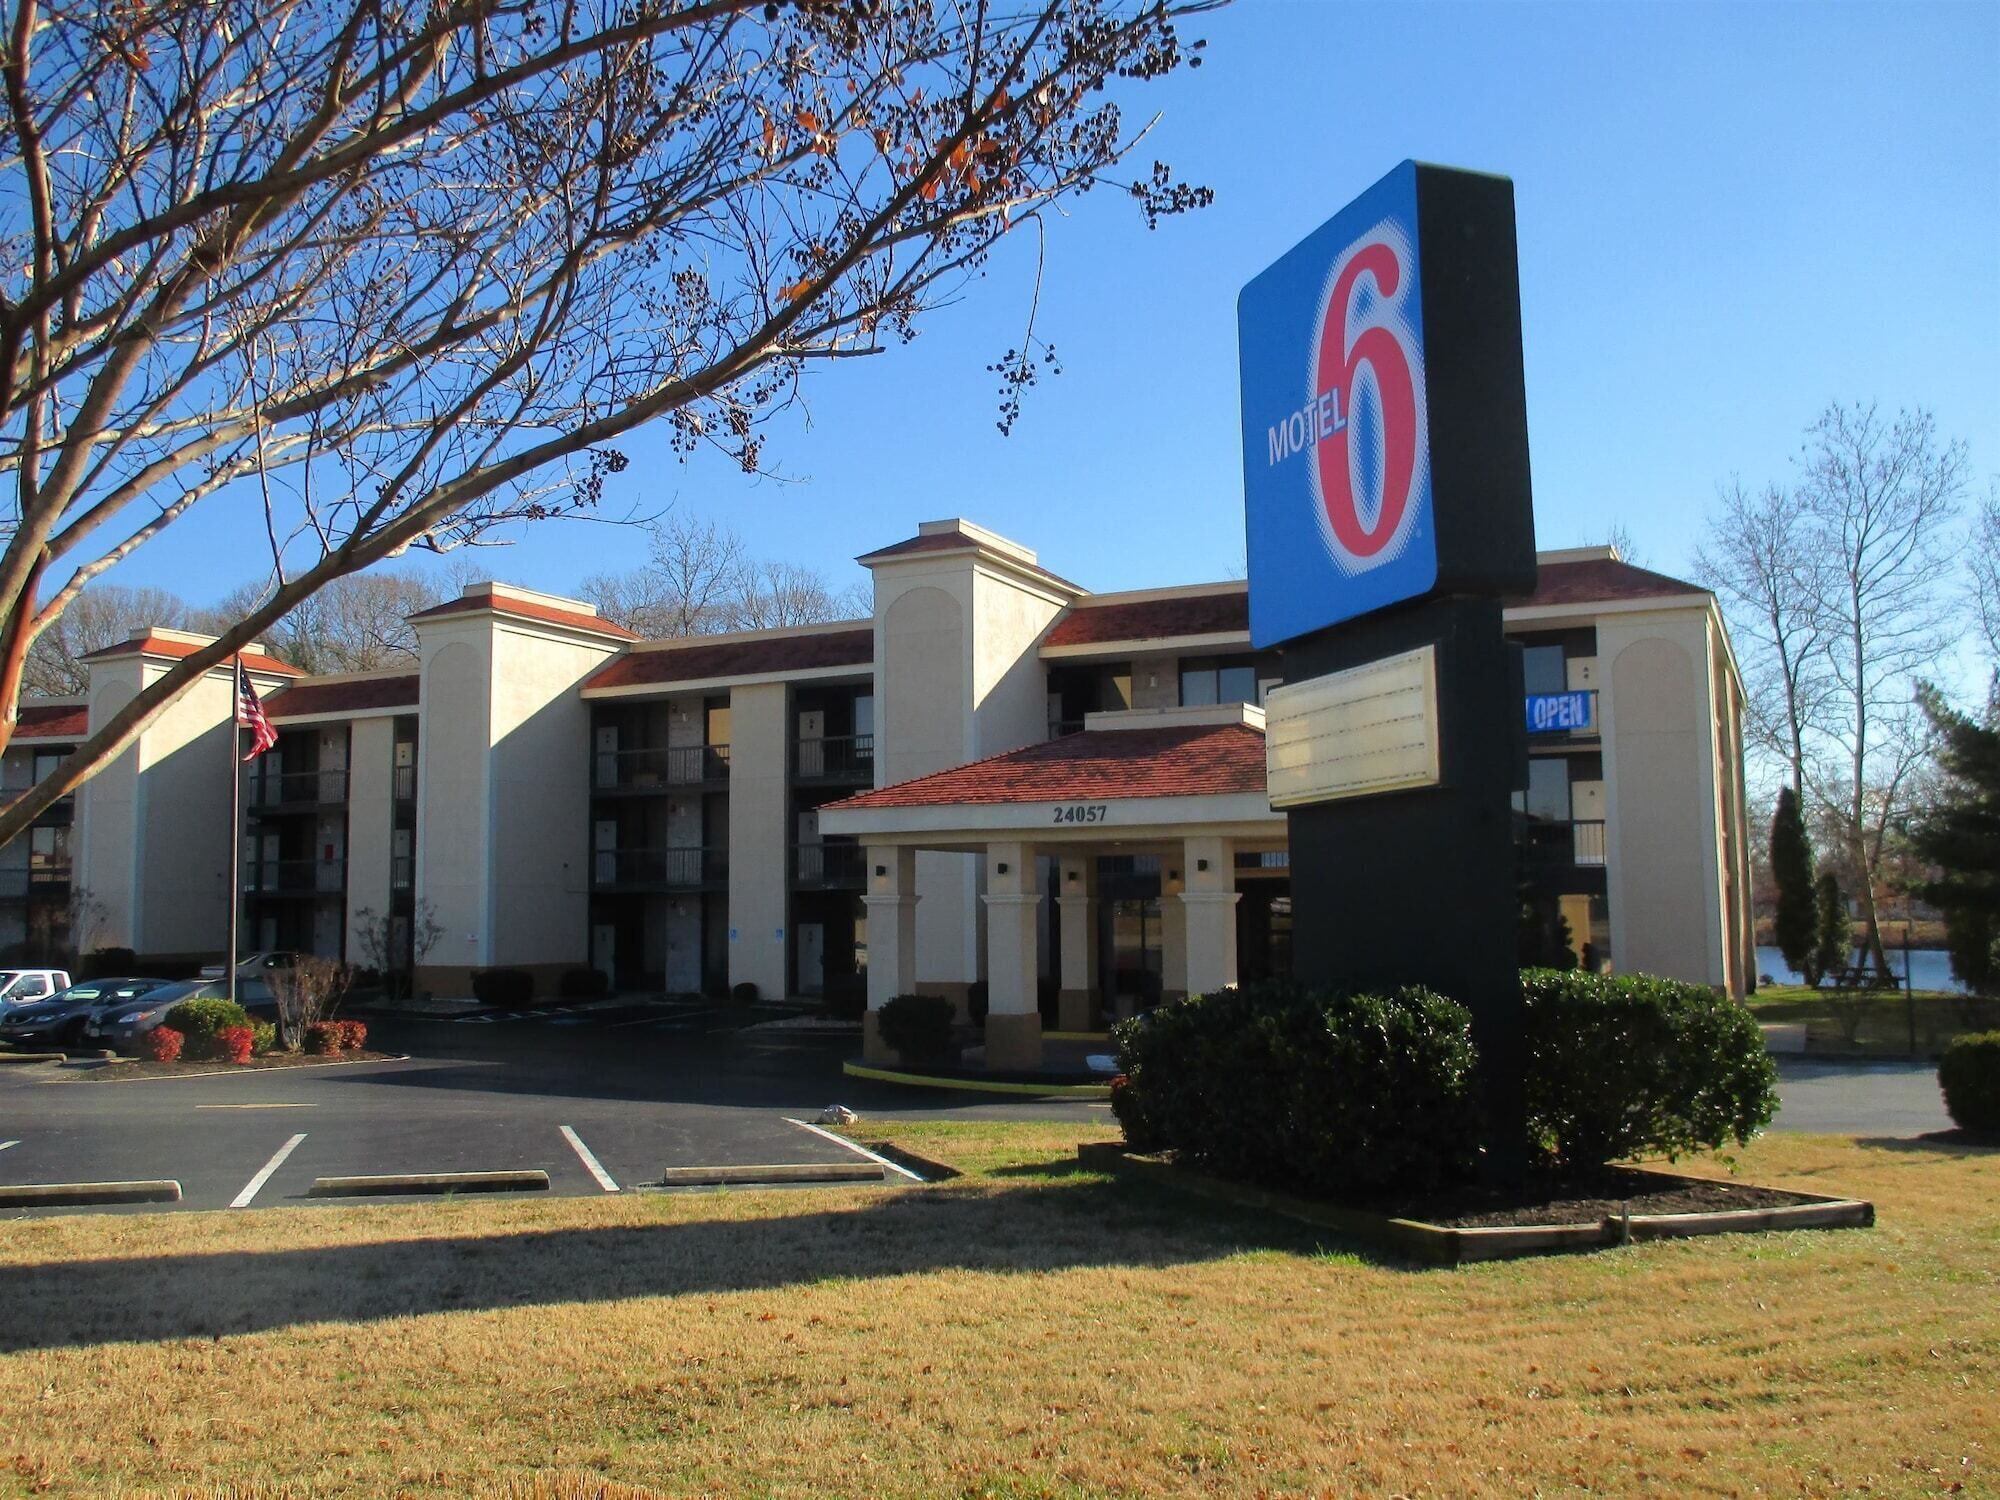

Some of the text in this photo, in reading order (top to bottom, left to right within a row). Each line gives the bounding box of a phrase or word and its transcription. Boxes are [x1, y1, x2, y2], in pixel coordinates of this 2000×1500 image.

[1268, 242, 1417, 558] MOTEL 6
[1533, 694, 1583, 729] OPEN
[1053, 805, 1107, 823] 24057
